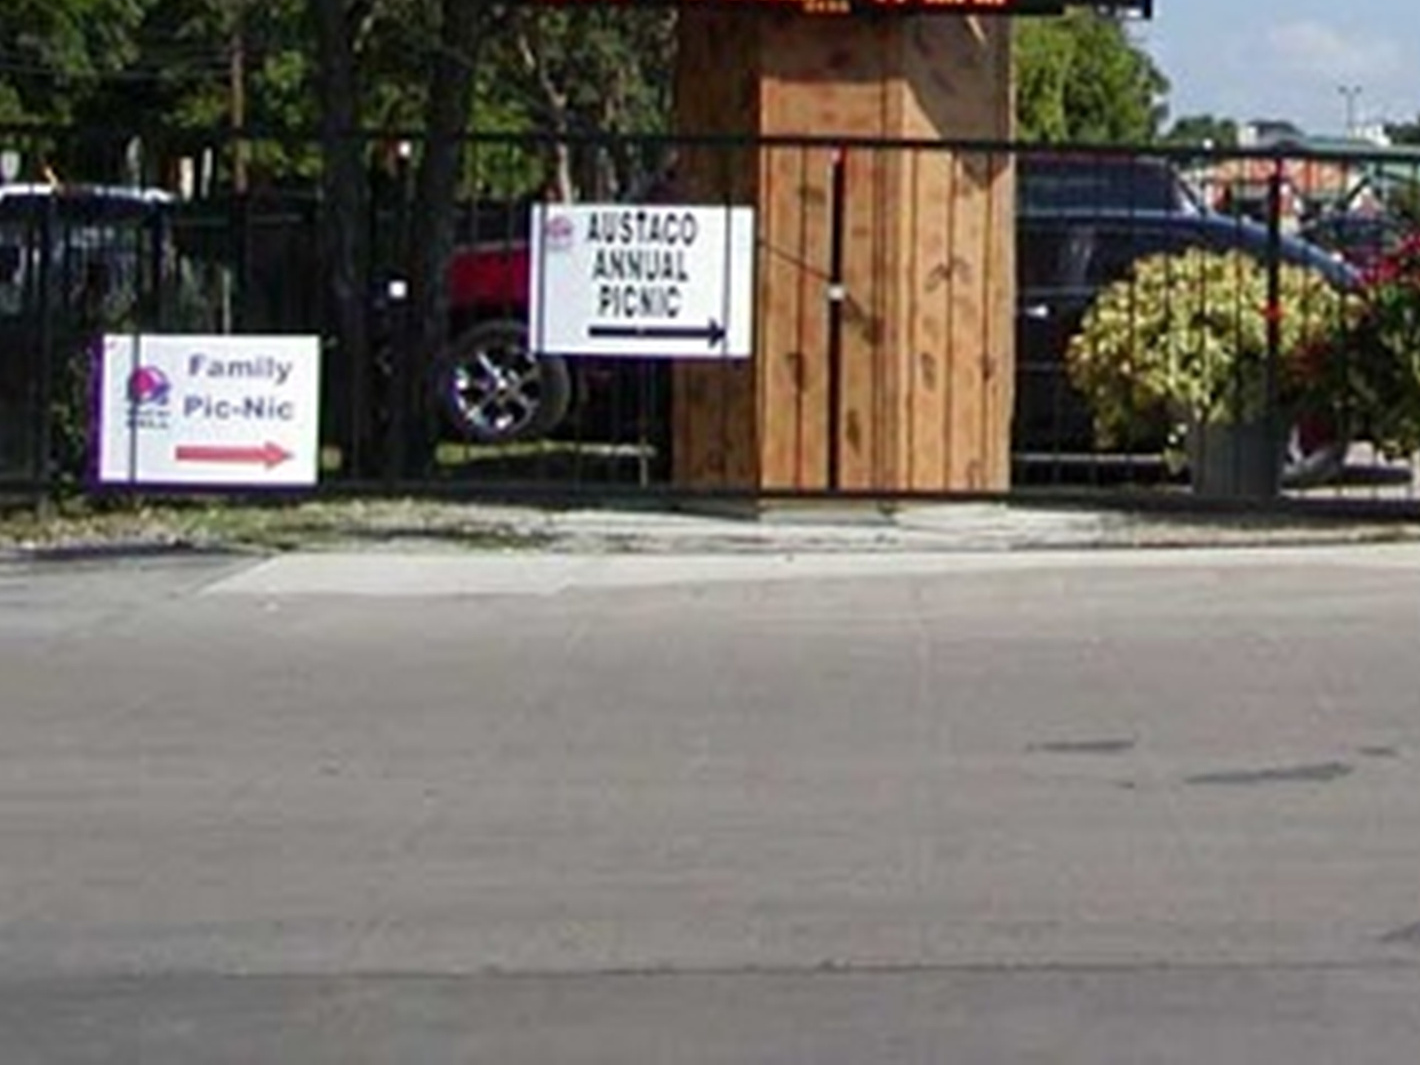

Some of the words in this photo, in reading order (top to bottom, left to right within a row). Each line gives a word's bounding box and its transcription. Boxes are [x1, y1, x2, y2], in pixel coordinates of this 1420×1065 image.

[586, 211, 698, 246] AUSTACO
[592, 248, 689, 282] ANNUAL
[598, 285, 682, 318] PICNIC
[188, 353, 294, 385] Family
[182, 394, 295, 421] Pic-Nic
